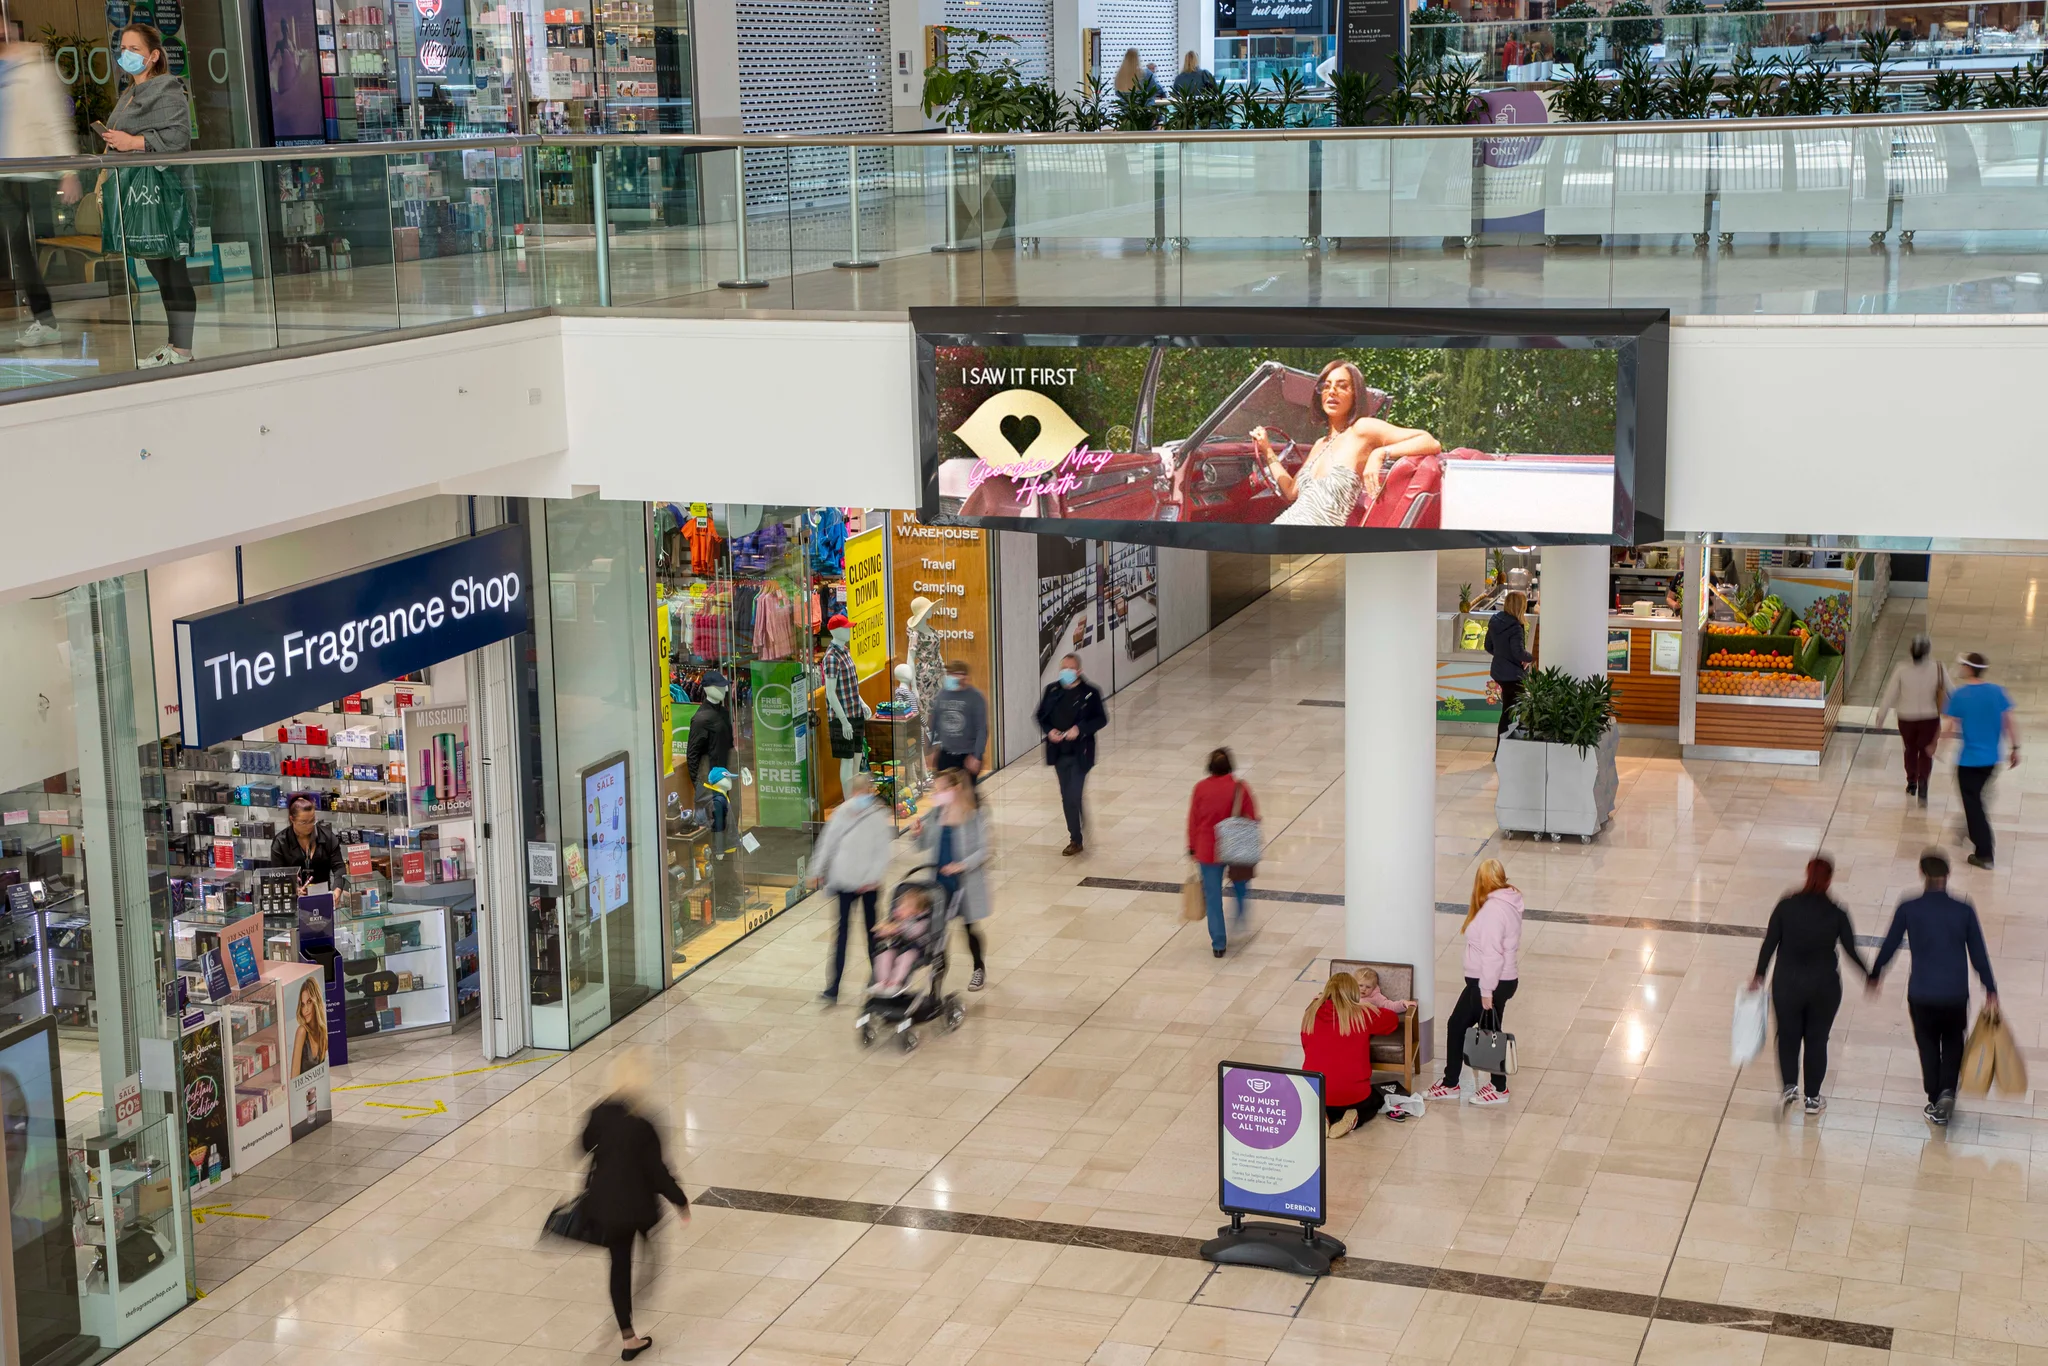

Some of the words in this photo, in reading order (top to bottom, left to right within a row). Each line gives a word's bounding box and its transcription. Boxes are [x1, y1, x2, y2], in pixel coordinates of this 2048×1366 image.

[1251, 5, 1271, 16] but
[1271, 4, 1312, 19] different
[420, 18, 440, 36] Free
[443, 18, 461, 37] Gift
[423, 40, 468, 66] Wrapping
[1490, 146, 1519, 156] ONLY
[128, 185, 160, 206] M&S
[962, 368, 967, 384] I
[970, 367, 1006, 385] SAW
[1010, 368, 1026, 385] IT
[1030, 368, 1077, 386] FIRST
[968, 457, 1054, 489] Georgia
[1060, 444, 1114, 473] May
[1015, 472, 1084, 505] Heath
[897, 526, 980, 540] WAREHOUSE
[848, 553, 882, 585] CLOSING
[921, 558, 956, 570] Travel
[855, 578, 879, 607] DOWN
[913, 580, 965, 596] Camping
[852, 611, 884, 641] EVERYTHING
[204, 651, 276, 701] The
[283, 596, 445, 674] Fragrance
[450, 570, 521, 621] Shop
[856, 637, 870, 657] MUST
[872, 632, 881, 649] GO
[761, 697, 782, 705] FREE
[164, 703, 180, 716] The
[760, 768, 802, 782] FREE
[596, 776, 615, 792] SALE
[760, 785, 803, 794] DELIVERY
[428, 803, 446, 812] real
[446, 800, 470, 810] babe
[366, 928, 383, 937] 70%
[196, 1041, 217, 1060] Jeans
[293, 1065, 325, 1089] TRUSSARDI
[119, 1085, 136, 1100] SALE
[184, 1076, 214, 1102] Cocktail
[1237, 1094, 1255, 1104] YOU
[1257, 1097, 1280, 1107] MUST
[187, 1097, 219, 1124] Edition
[1231, 1102, 1256, 1113] WEAR
[1257, 1106, 1264, 1114] A
[1266, 1107, 1287, 1117] FACE
[1231, 1112, 1274, 1125] COVERING
[1276, 1118, 1287, 1126] AT
[1238, 1122, 1254, 1131] ALL
[1255, 1124, 1280, 1135] TIMES
[241, 1122, 284, 1152] thefragranceshop.co.uk
[1285, 1202, 1316, 1213] DERBION
[125, 1281, 178, 1319] thefragranceshop.co.uk
